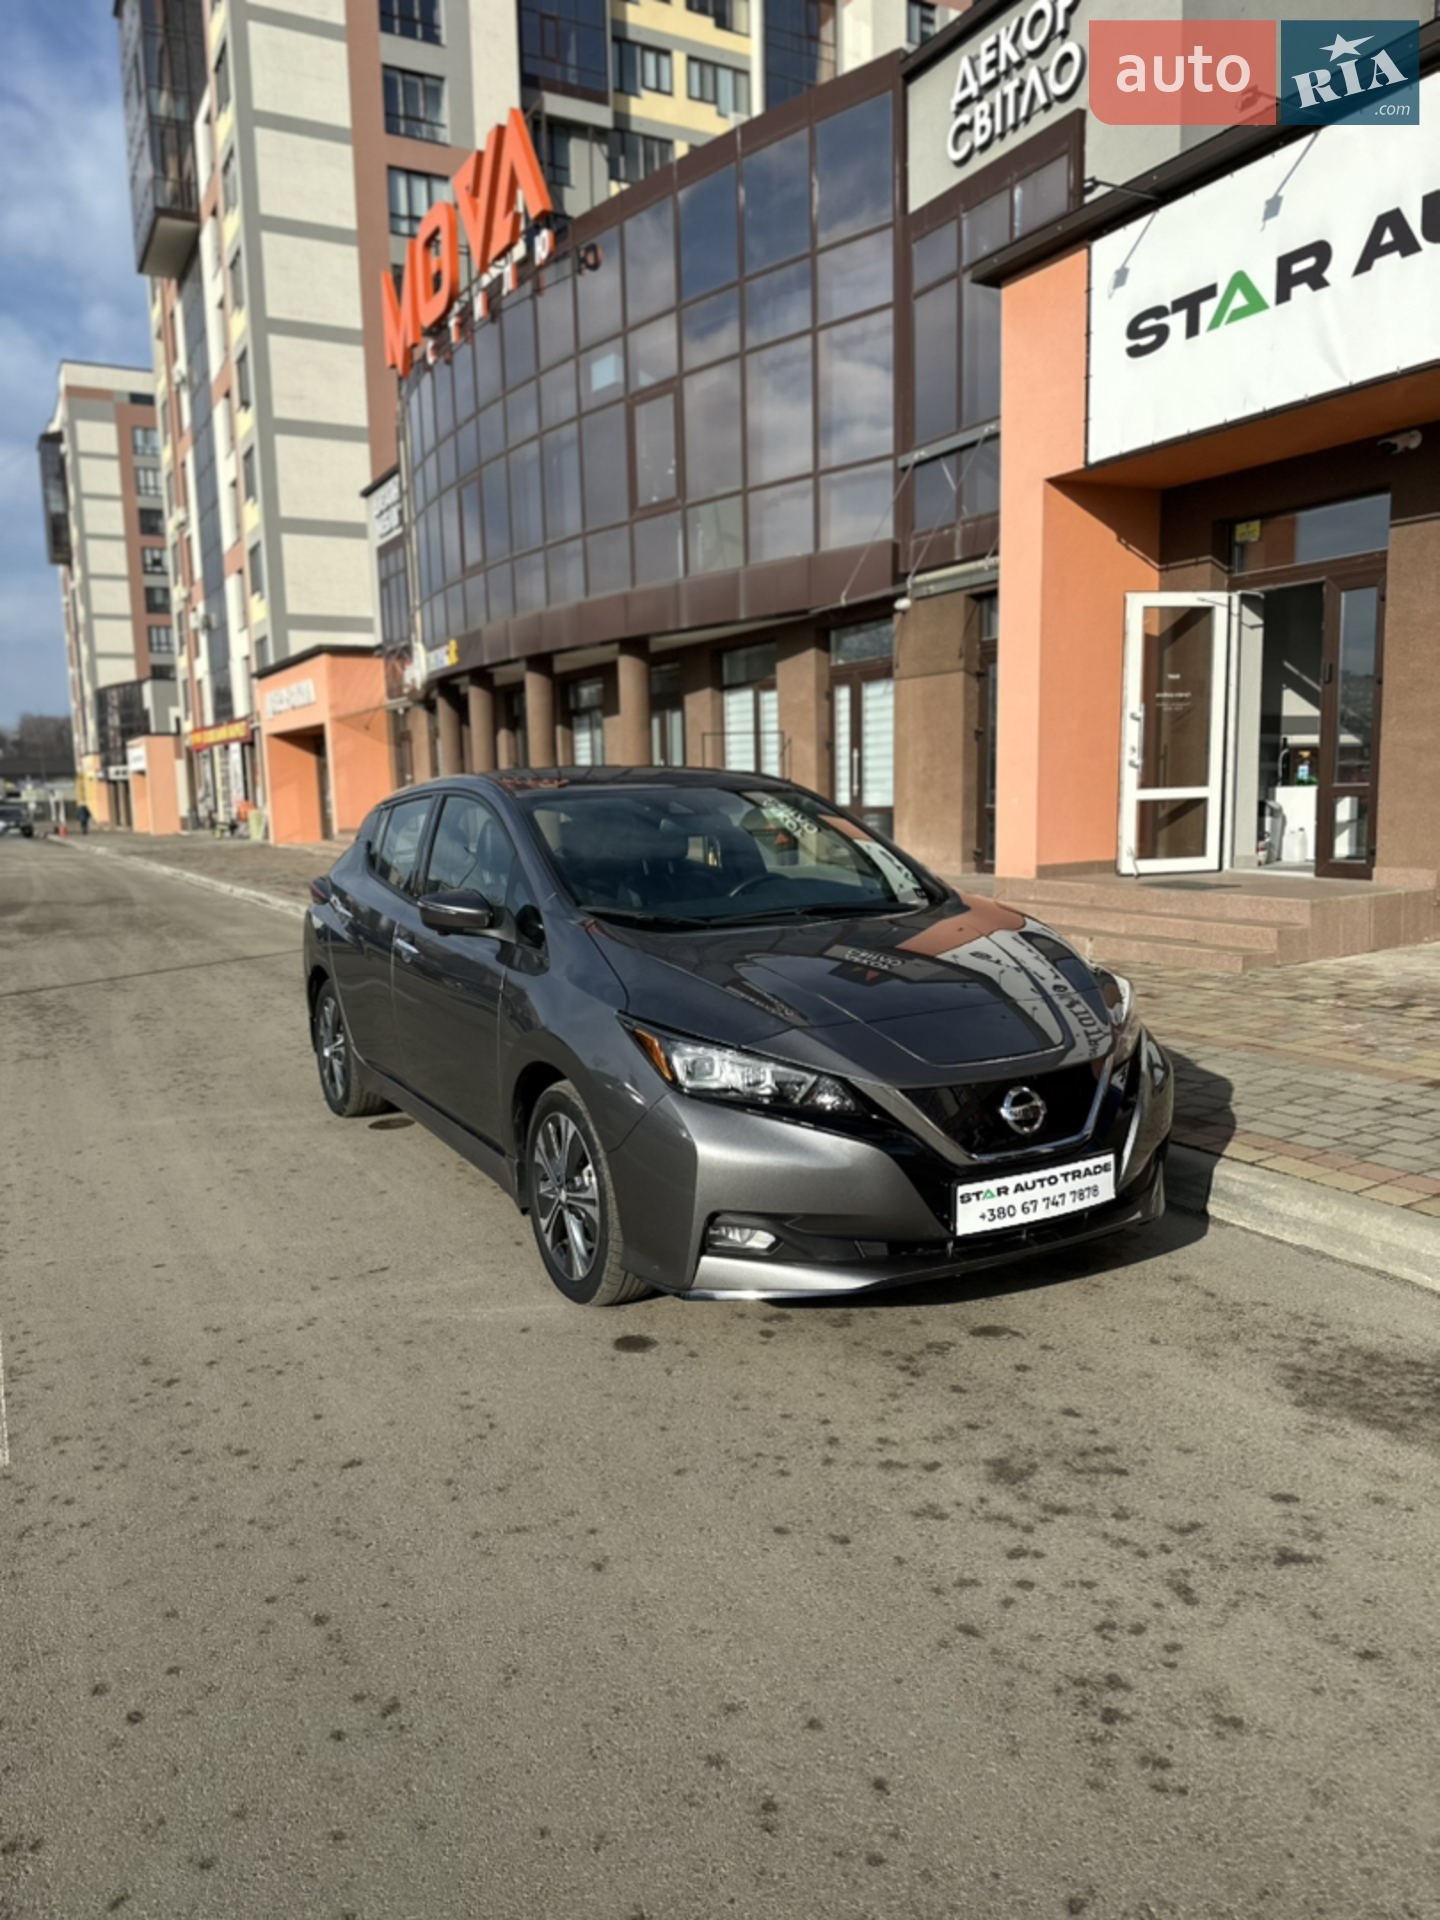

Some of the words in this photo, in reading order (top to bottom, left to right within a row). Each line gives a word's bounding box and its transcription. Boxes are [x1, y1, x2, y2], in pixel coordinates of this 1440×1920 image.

[947, 41, 1082, 161] СВІТЛО
[951, 0, 1076, 111] ДЕКОР
[1125, 239, 1333, 359] STAR
[959, 1185, 1010, 1204] STAR
[1013, 1174, 1059, 1194] AUTO
[1060, 1161, 1112, 1183] TRADE
[978, 1204, 1017, 1222] +380
[1021, 1199, 1038, 1215] 67
[1042, 1193, 1067, 1210] 747
[1070, 1184, 1100, 1203] 7878
